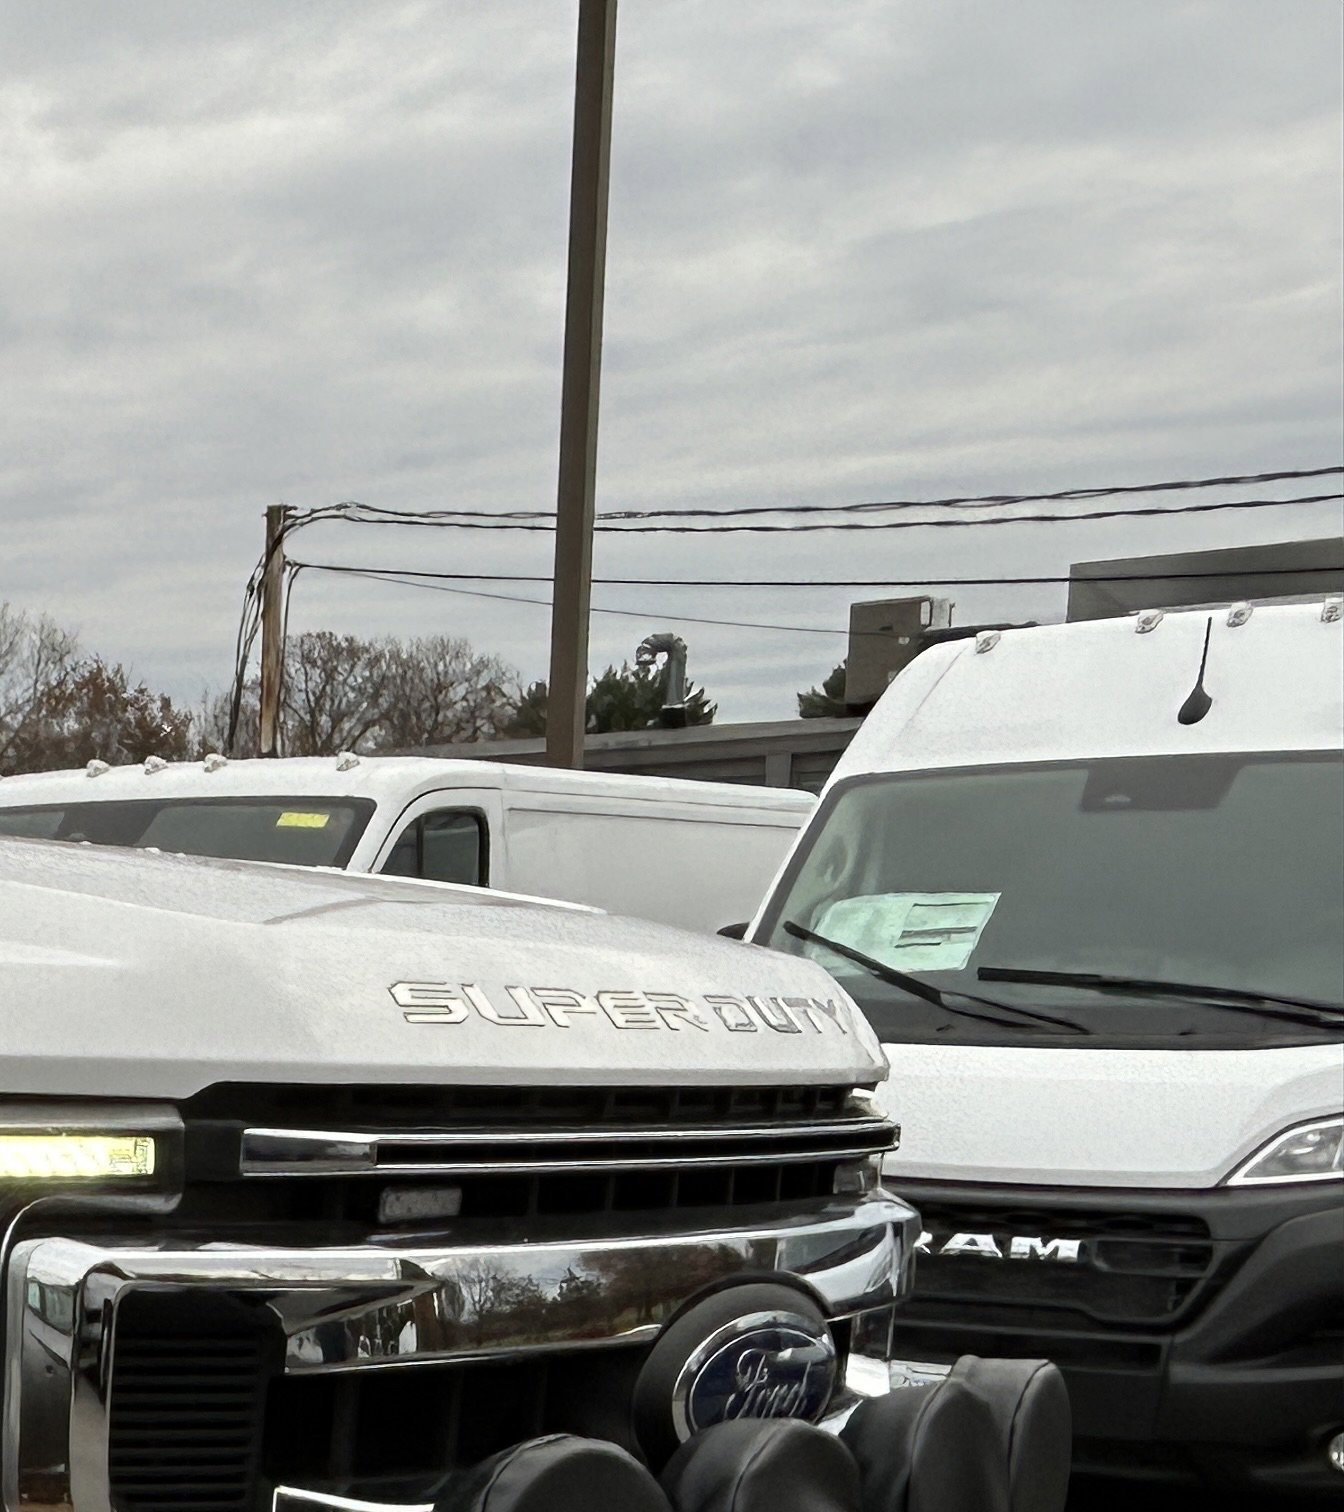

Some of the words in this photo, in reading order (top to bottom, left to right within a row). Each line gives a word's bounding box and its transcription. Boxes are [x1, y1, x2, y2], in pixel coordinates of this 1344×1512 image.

[386, 979, 711, 1033] SUPER
[702, 993, 850, 1036] DUTY
[722, 1347, 813, 1420] Ford
